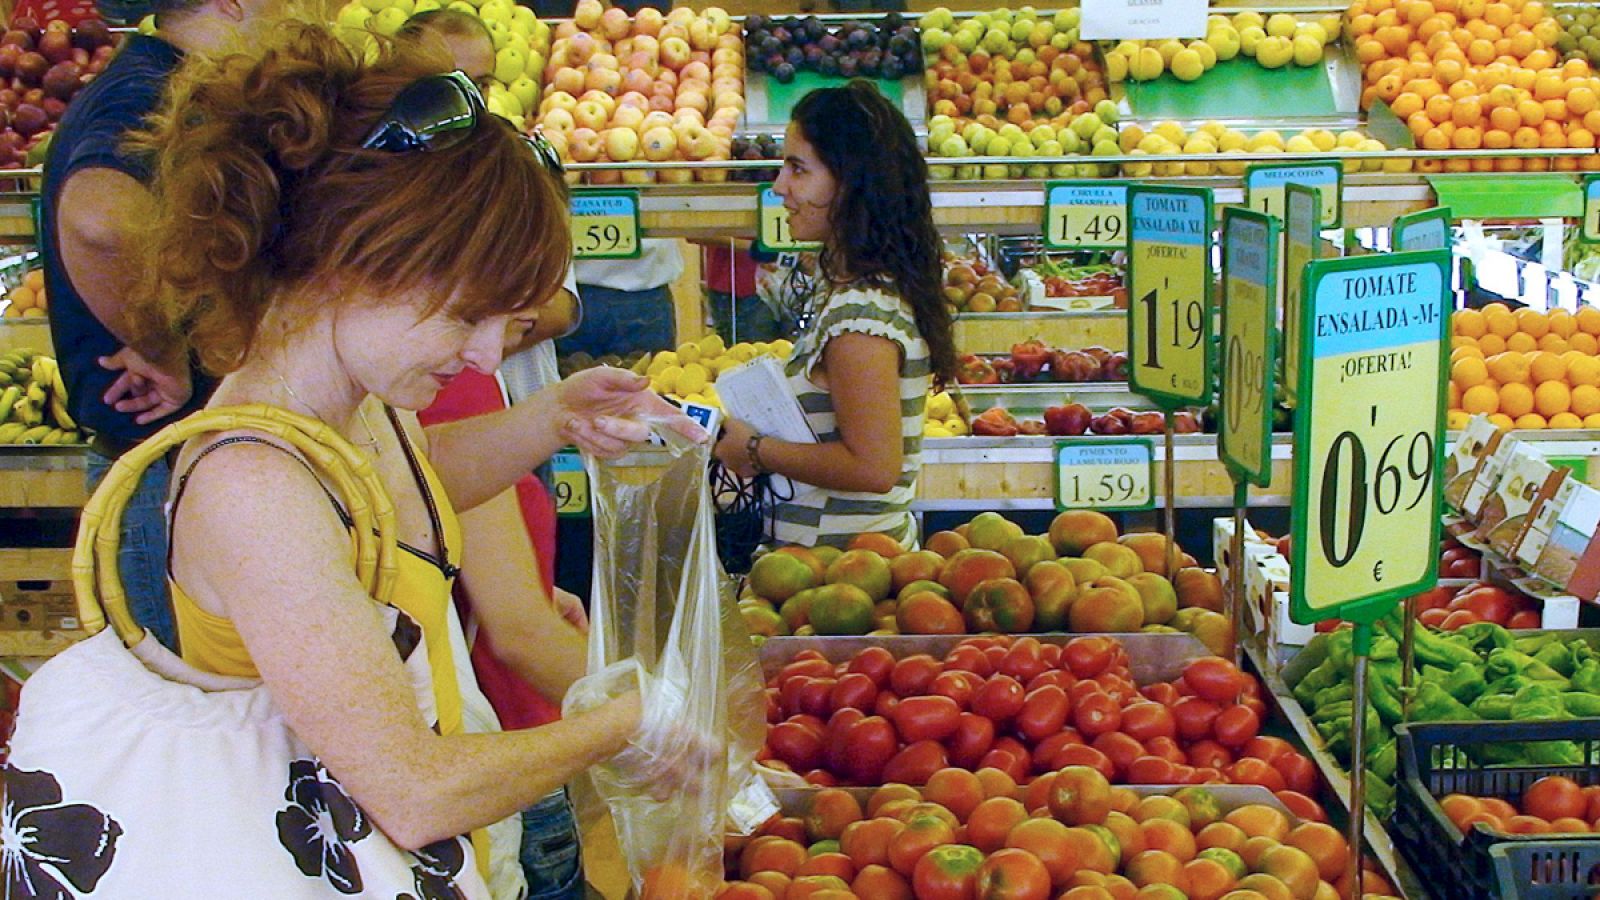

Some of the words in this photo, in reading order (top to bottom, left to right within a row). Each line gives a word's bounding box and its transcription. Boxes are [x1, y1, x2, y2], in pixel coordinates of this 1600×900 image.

[1145, 198, 1189, 213] TOMATE
[577, 224, 620, 251] ,59
[1061, 214, 1122, 246] 1,49
[1133, 216, 1185, 232] ENSALADA
[1188, 219, 1203, 235] XL
[1343, 272, 1418, 300] TOMATE
[1316, 306, 1409, 337] ENSALADA
[1412, 303, 1440, 325] -M-
[1340, 352, 1412, 383] ¡OFERTA!
[1079, 447, 1128, 457] PIMIENTO
[1073, 473, 1134, 506] 1,59
